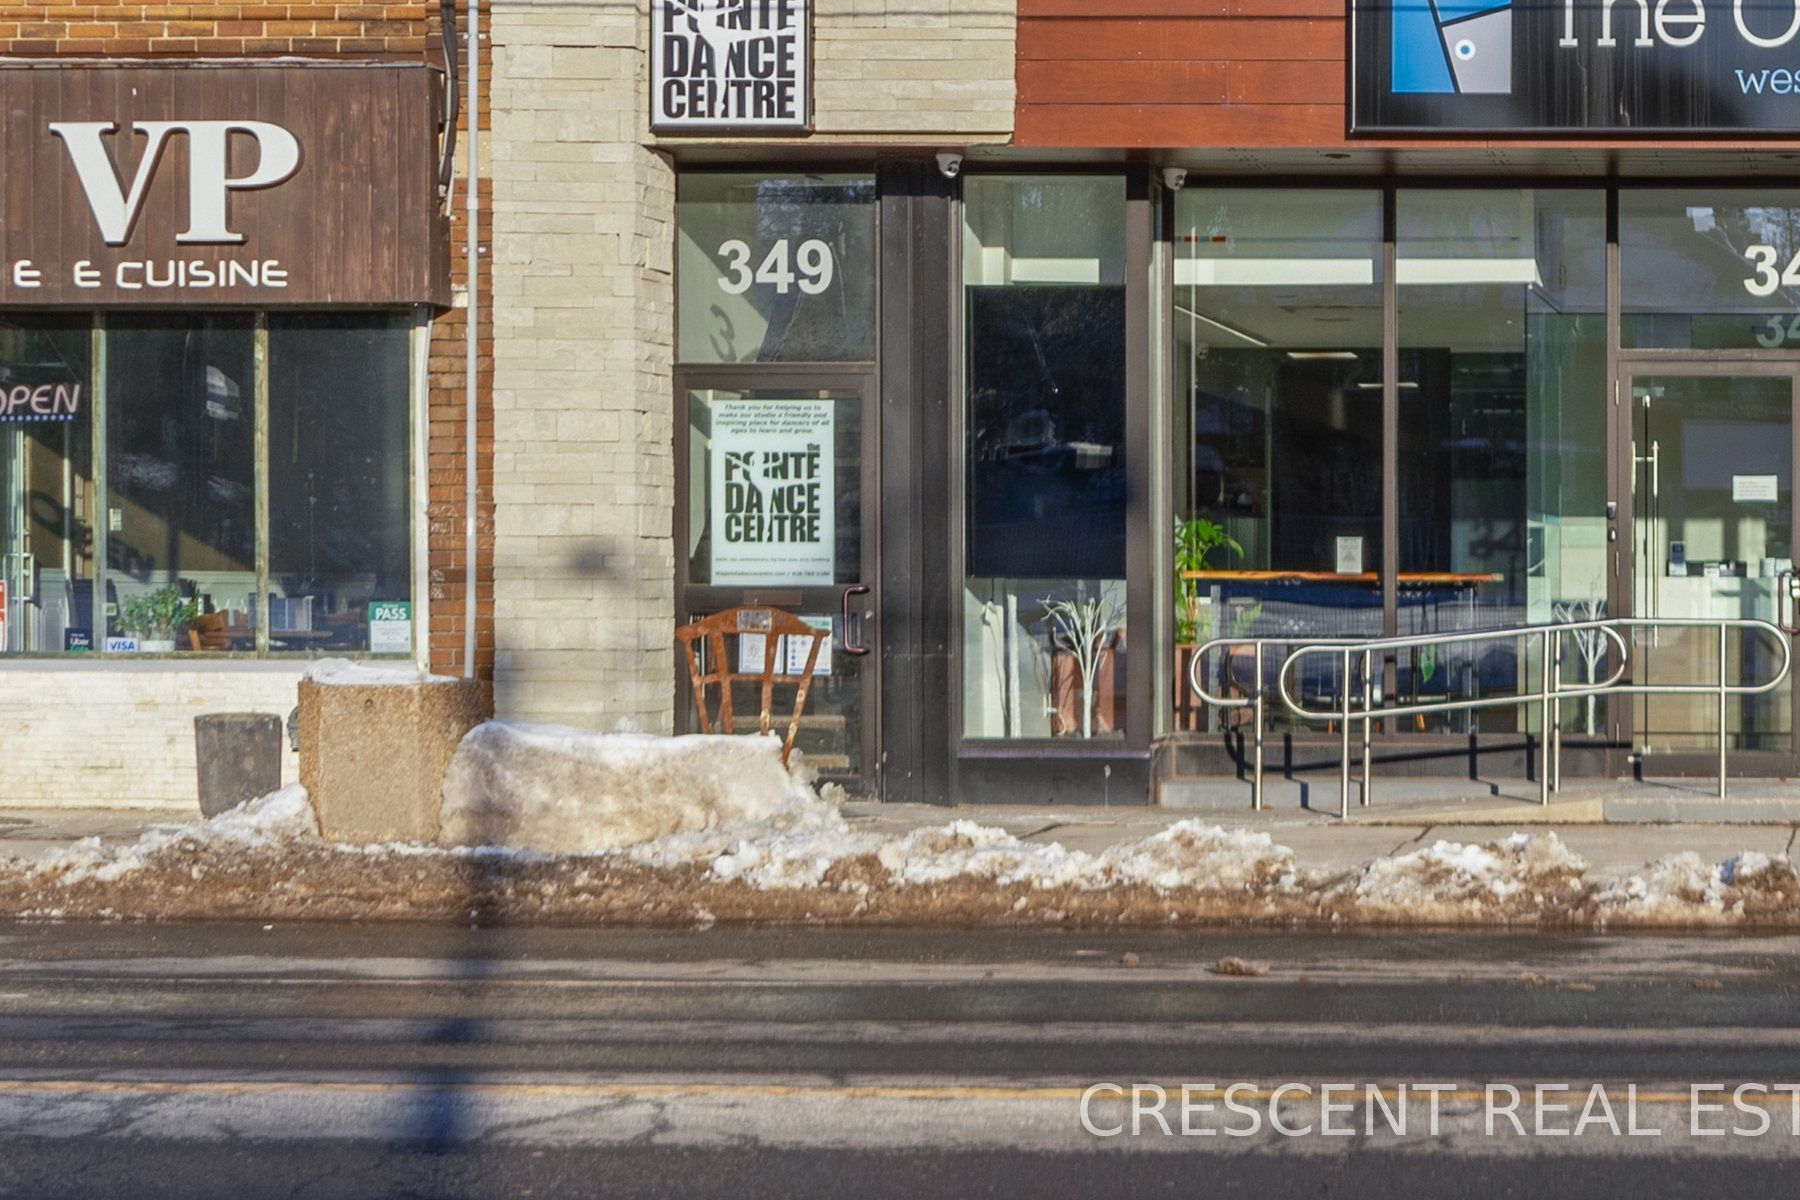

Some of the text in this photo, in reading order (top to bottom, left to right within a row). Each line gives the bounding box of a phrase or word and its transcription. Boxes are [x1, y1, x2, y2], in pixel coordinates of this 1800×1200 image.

[663, 35, 796, 79] DANCE
[663, 79, 796, 119] CENTRE
[49, 120, 302, 246] VP
[116, 260, 288, 289] CUISINE
[717, 239, 833, 295] 349
[807, 443, 820, 451] the
[725, 482, 820, 513] DANCE
[725, 514, 820, 543] CENTRE
[375, 607, 407, 620] PASS
[111, 641, 135, 650] VISA
